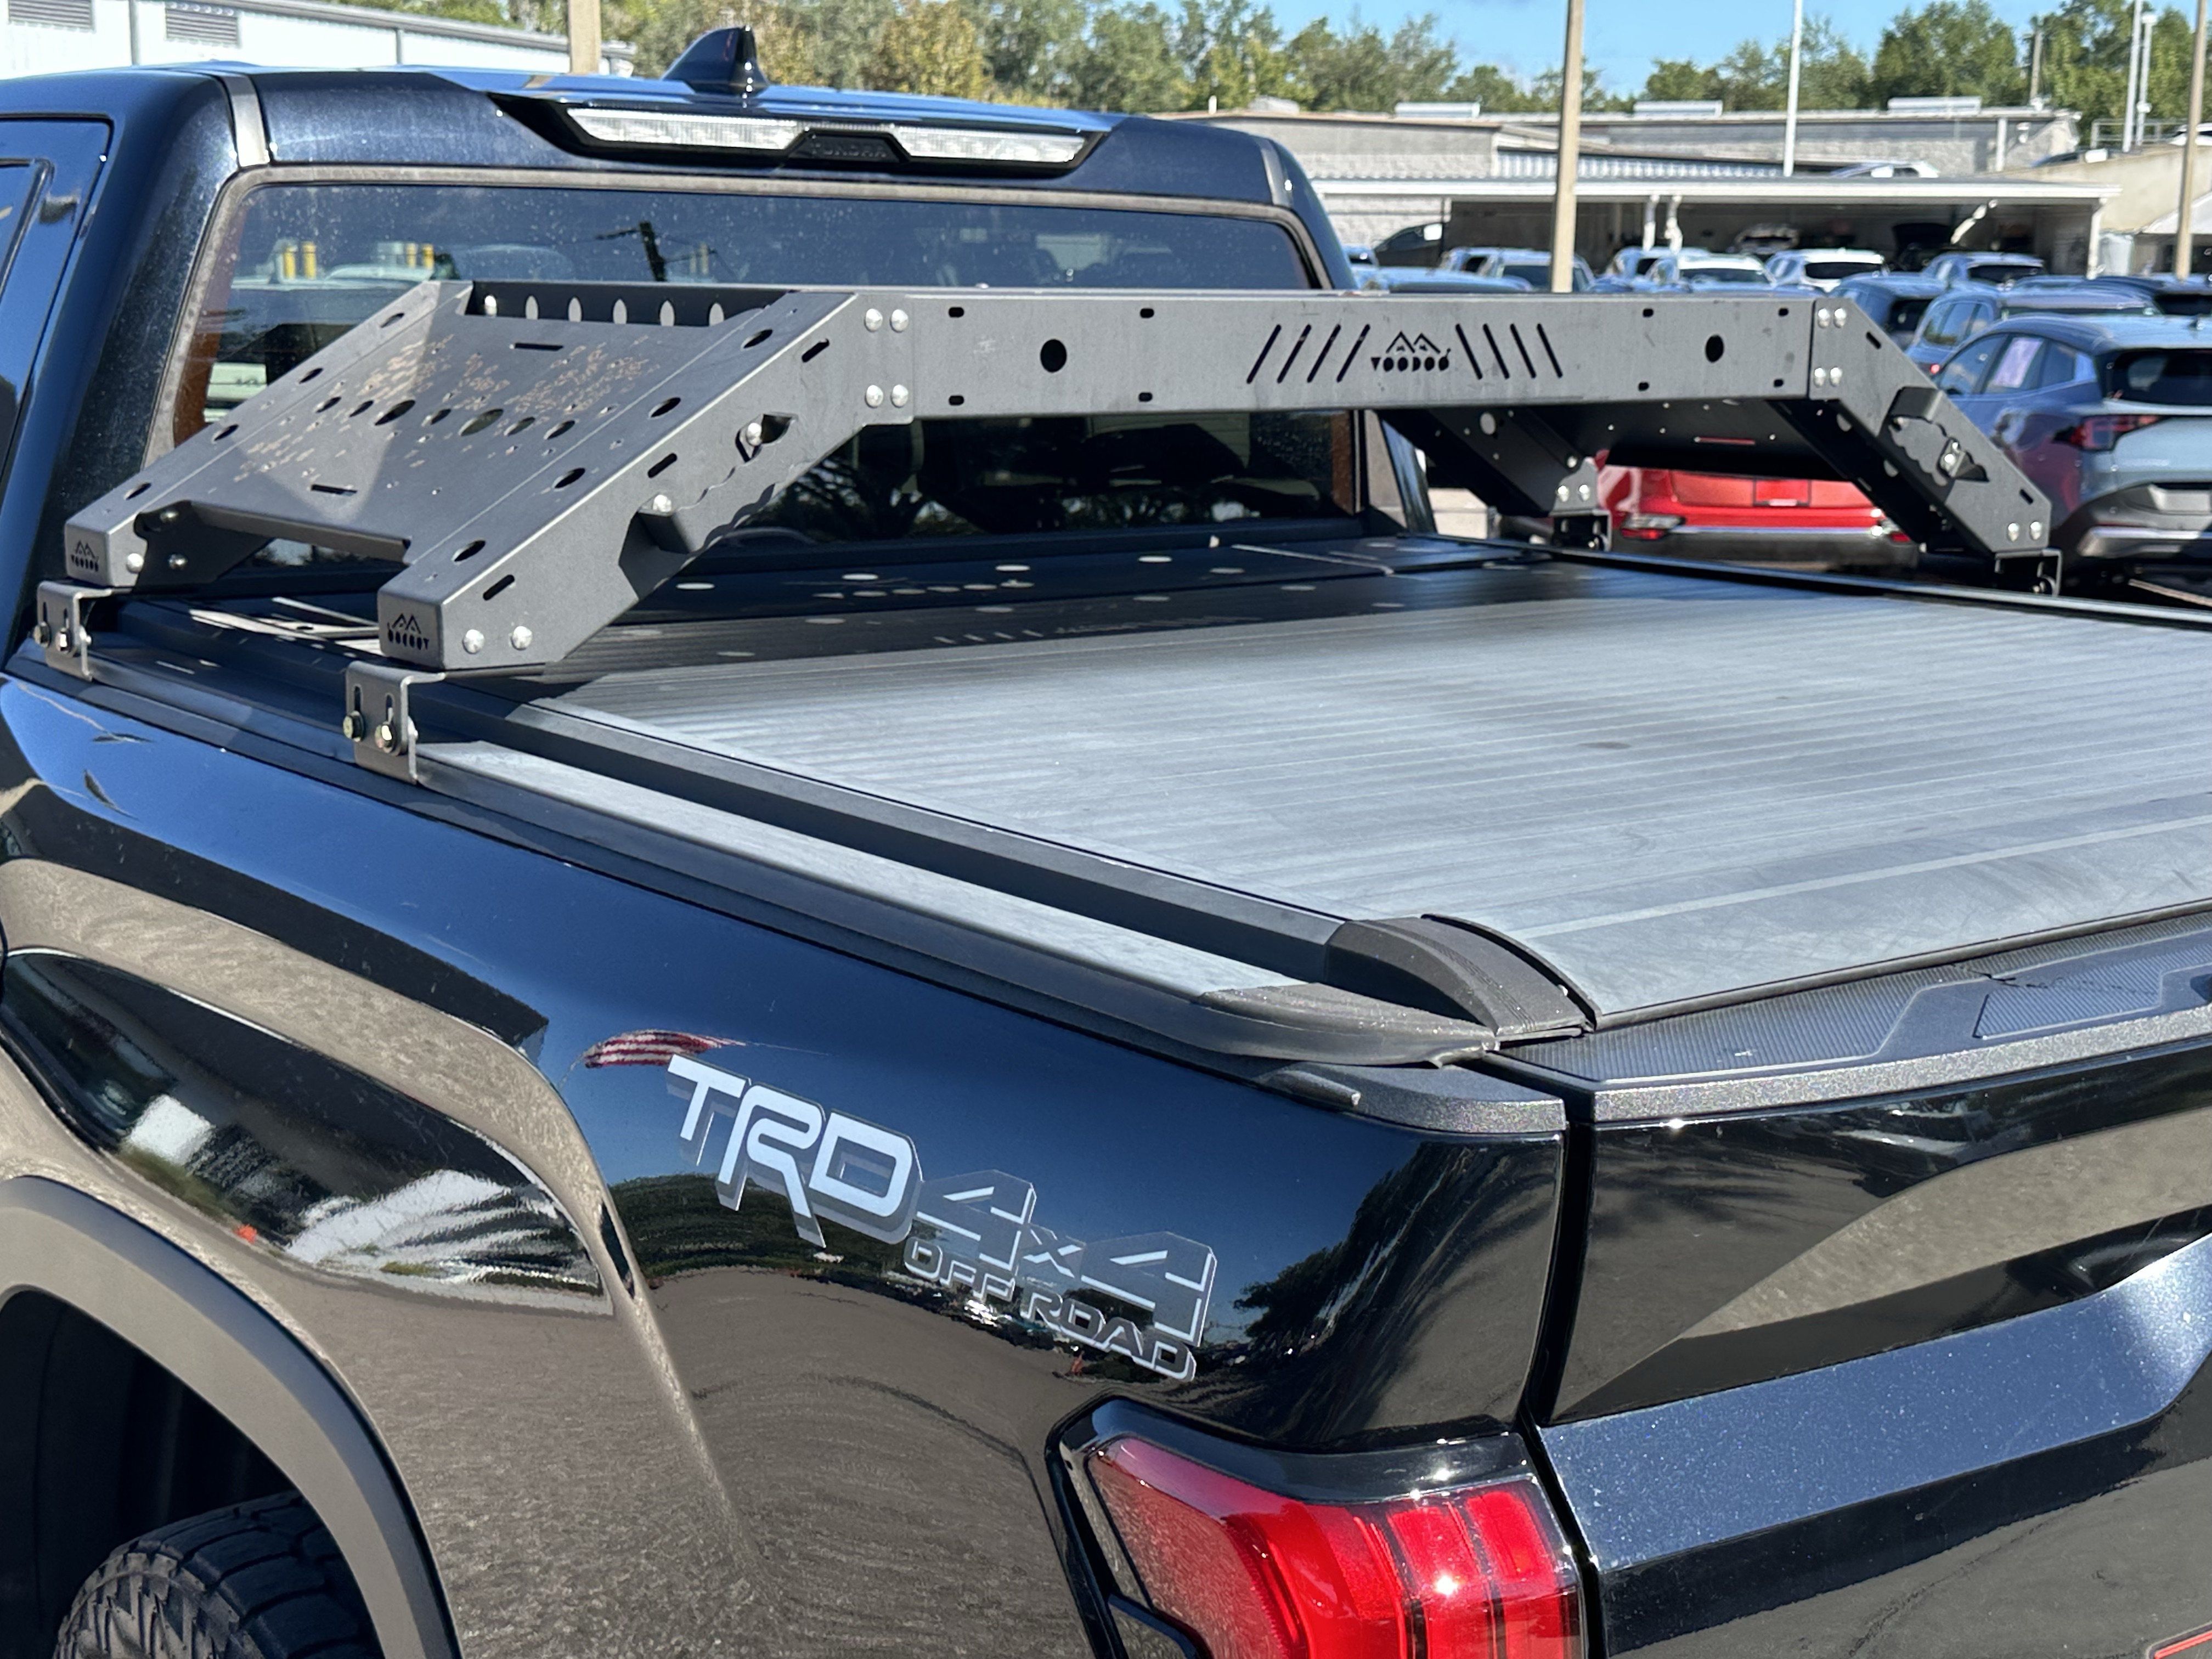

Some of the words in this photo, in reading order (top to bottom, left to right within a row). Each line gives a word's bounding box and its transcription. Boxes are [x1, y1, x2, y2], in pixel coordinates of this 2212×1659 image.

[1370, 354, 1450, 371] VOODOO
[666, 1053, 923, 1246] TRD
[904, 1236, 1016, 1302] OFF
[1019, 1278, 1197, 1383] ROAD
